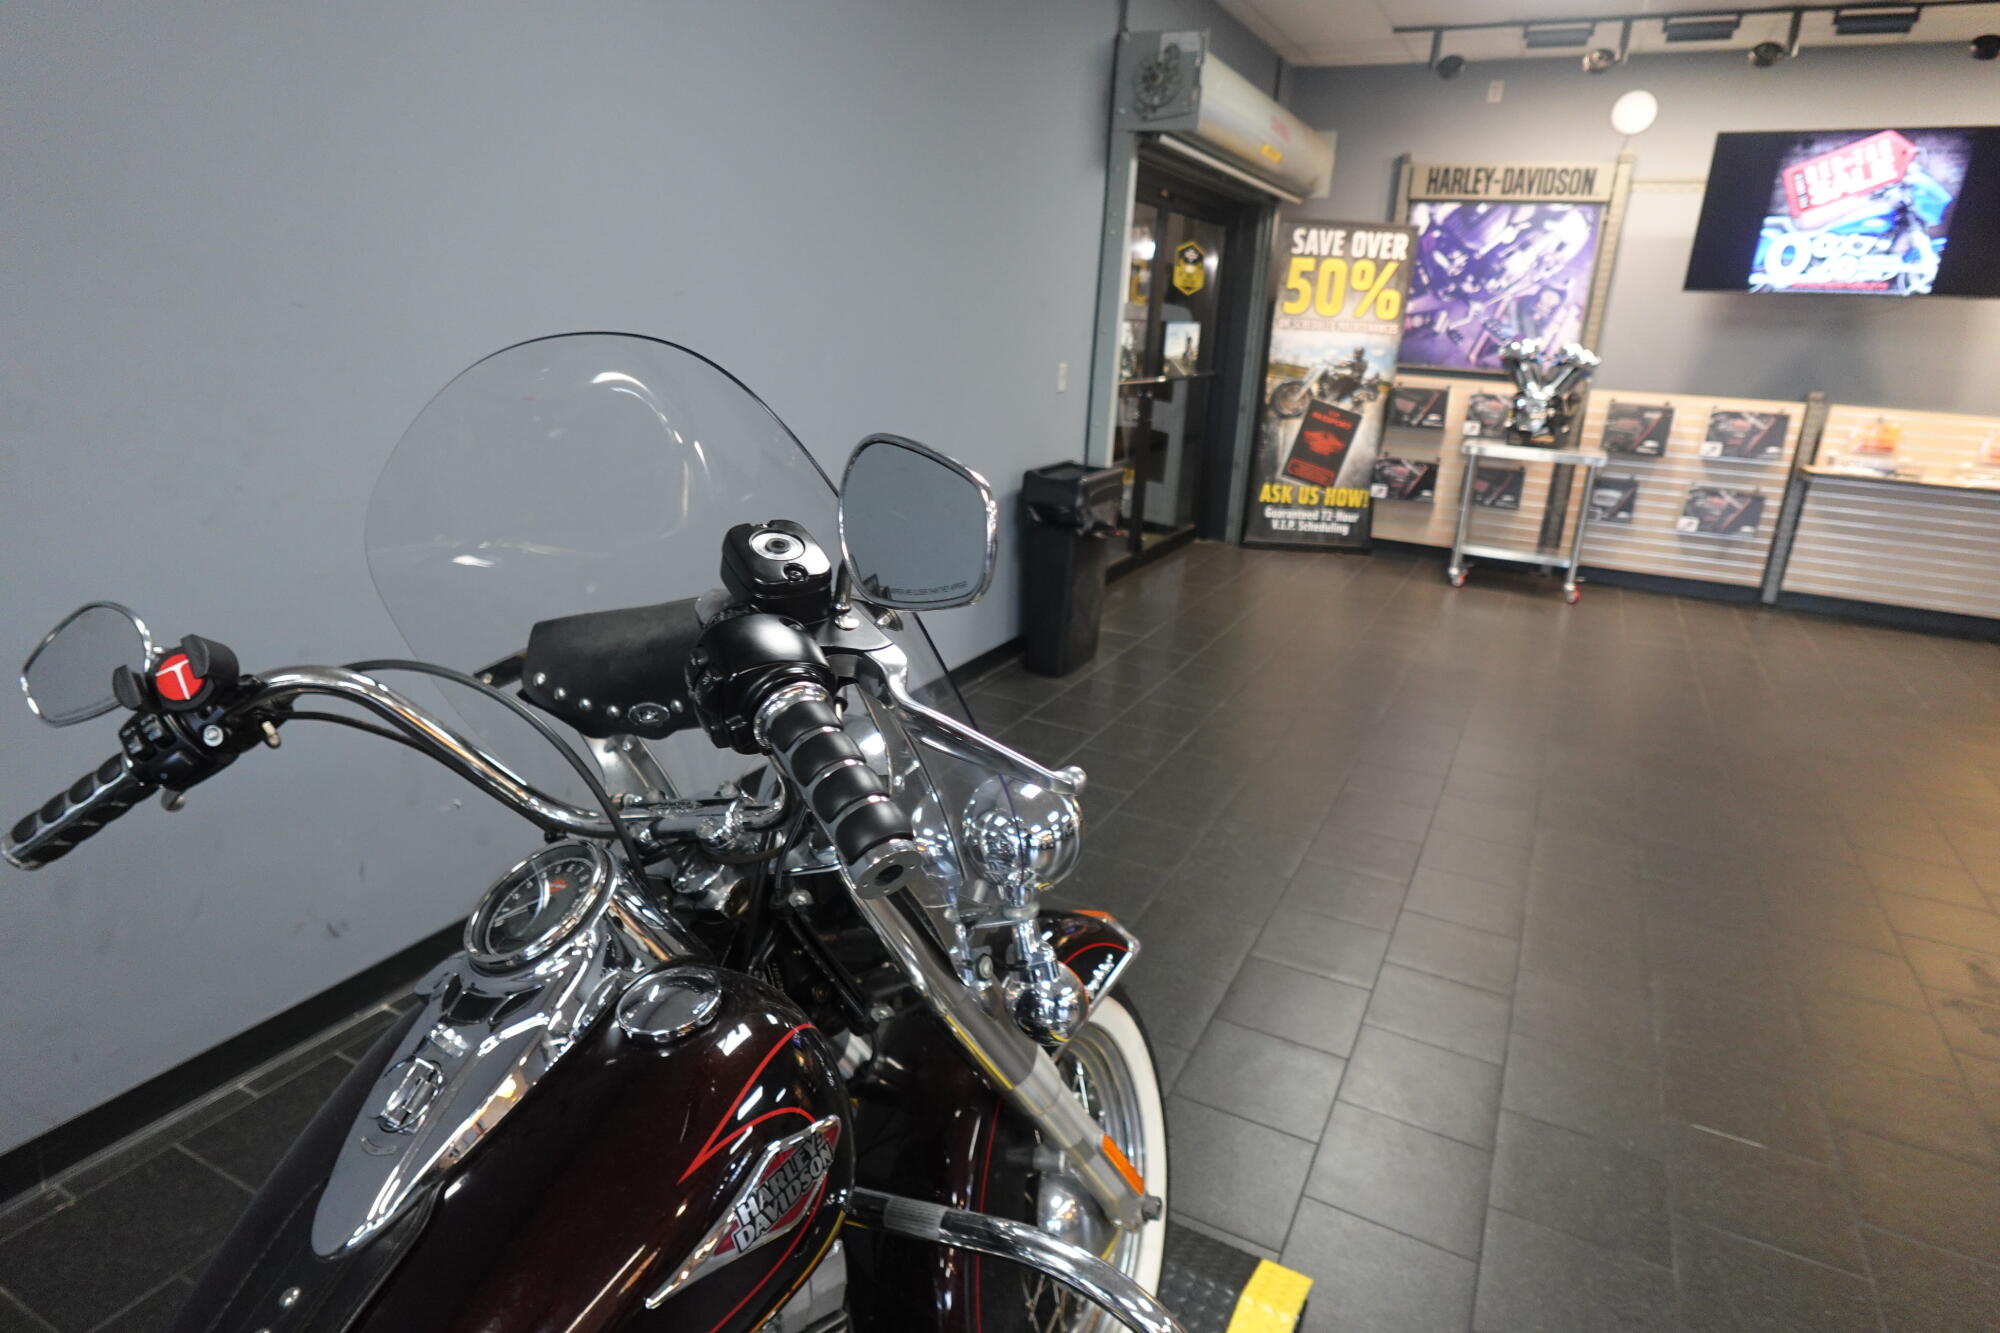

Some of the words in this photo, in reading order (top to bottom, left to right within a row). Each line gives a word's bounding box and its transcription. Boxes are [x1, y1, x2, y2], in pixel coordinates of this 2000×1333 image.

[1426, 166, 1598, 196] HARLEY-DAVIDSON
[1290, 227, 1347, 257] SAVE
[1350, 230, 1410, 260] OVER
[1282, 256, 1402, 321] 50%
[1258, 482, 1293, 504] ASK
[1298, 486, 1320, 506] US
[1323, 487, 1371, 508] HOW!
[734, 1143, 835, 1253] DAVIDSON
